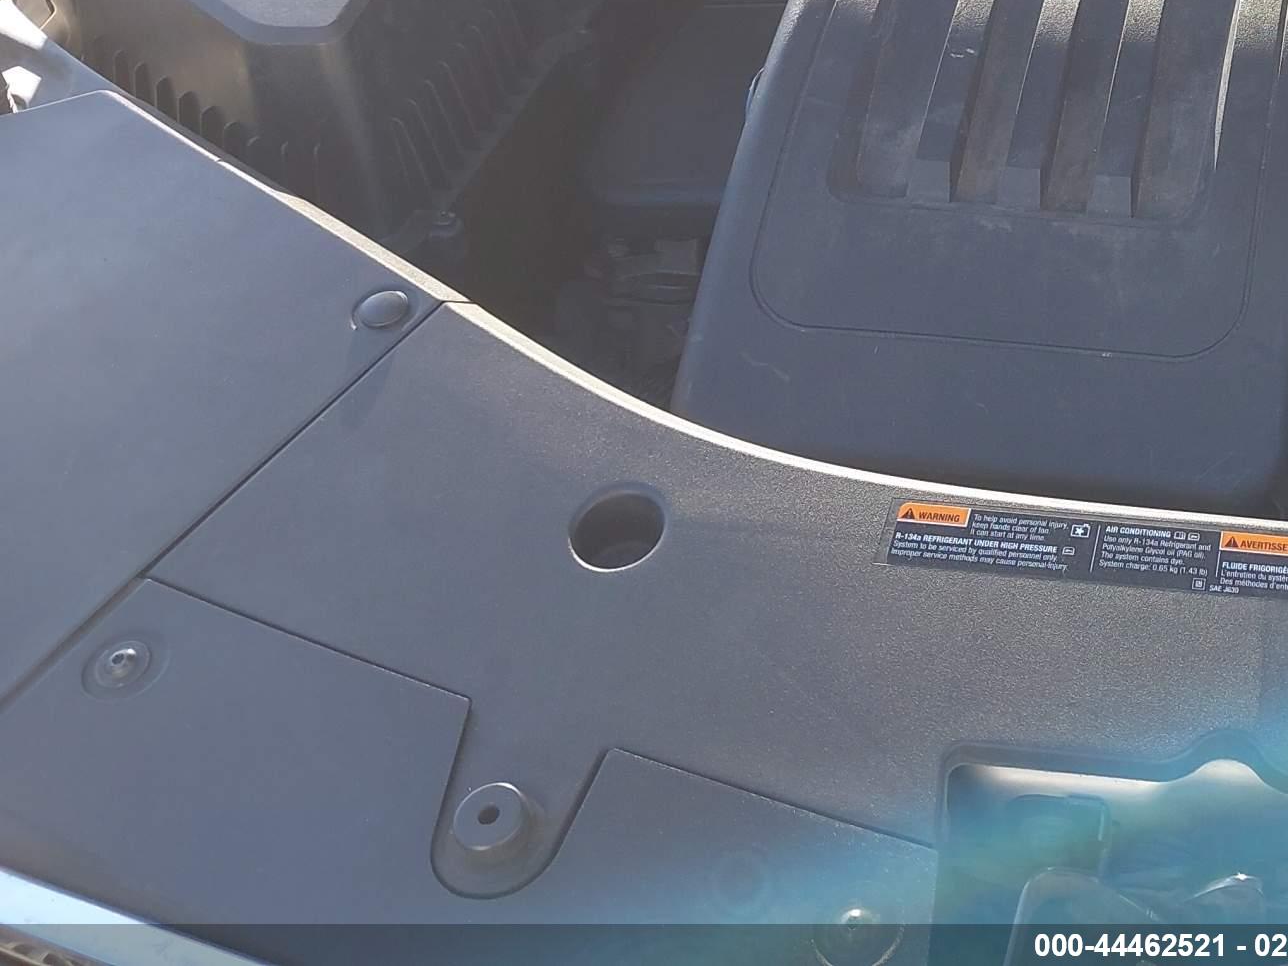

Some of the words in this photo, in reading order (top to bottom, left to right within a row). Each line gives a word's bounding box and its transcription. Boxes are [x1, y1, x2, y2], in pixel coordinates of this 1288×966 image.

[919, 512, 960, 523] WARNING
[984, 515, 997, 524] help
[1000, 516, 1017, 524] avoid
[1019, 518, 1046, 528] personal
[972, 522, 988, 530] keep
[1120, 527, 1171, 538] CONDITIONING
[895, 532, 921, 541] R-134a
[923, 535, 972, 545] REFRIGERANT
[974, 539, 999, 548] UNDER
[1001, 542, 1018, 550] HIGH
[1020, 543, 1057, 553] PRESSURE
[1118, 537, 1132, 545] only
[1134, 538, 1158, 546] R-134a
[1160, 540, 1197, 550] Refrigerant
[893, 540, 917, 549] System
[939, 544, 967, 552] serviced
[979, 548, 1006, 558] qualified
[1008, 551, 1040, 561] personnel
[1103, 543, 1143, 554] Polyalkylene
[1145, 547, 1165, 556] Glycol
[1177, 550, 1192, 558] (PAG
[891, 548, 922, 558] Improper
[923, 551, 947, 559] service
[949, 553, 978, 562] methods
[1017, 560, 1046, 569] personal
[1115, 553, 1139, 562] system
[1141, 555, 1168, 564] contains
[1170, 557, 1185, 566] dye.
[1099, 560, 1123, 569] System
[1126, 562, 1151, 572] charge:
[1152, 564, 1168, 572] 0.65
[1180, 567, 1197, 575] (1.43
[1199, 568, 1207, 576] lb)
[1222, 562, 1247, 571] FLUIDE
[1209, 584, 1222, 592] SAE
